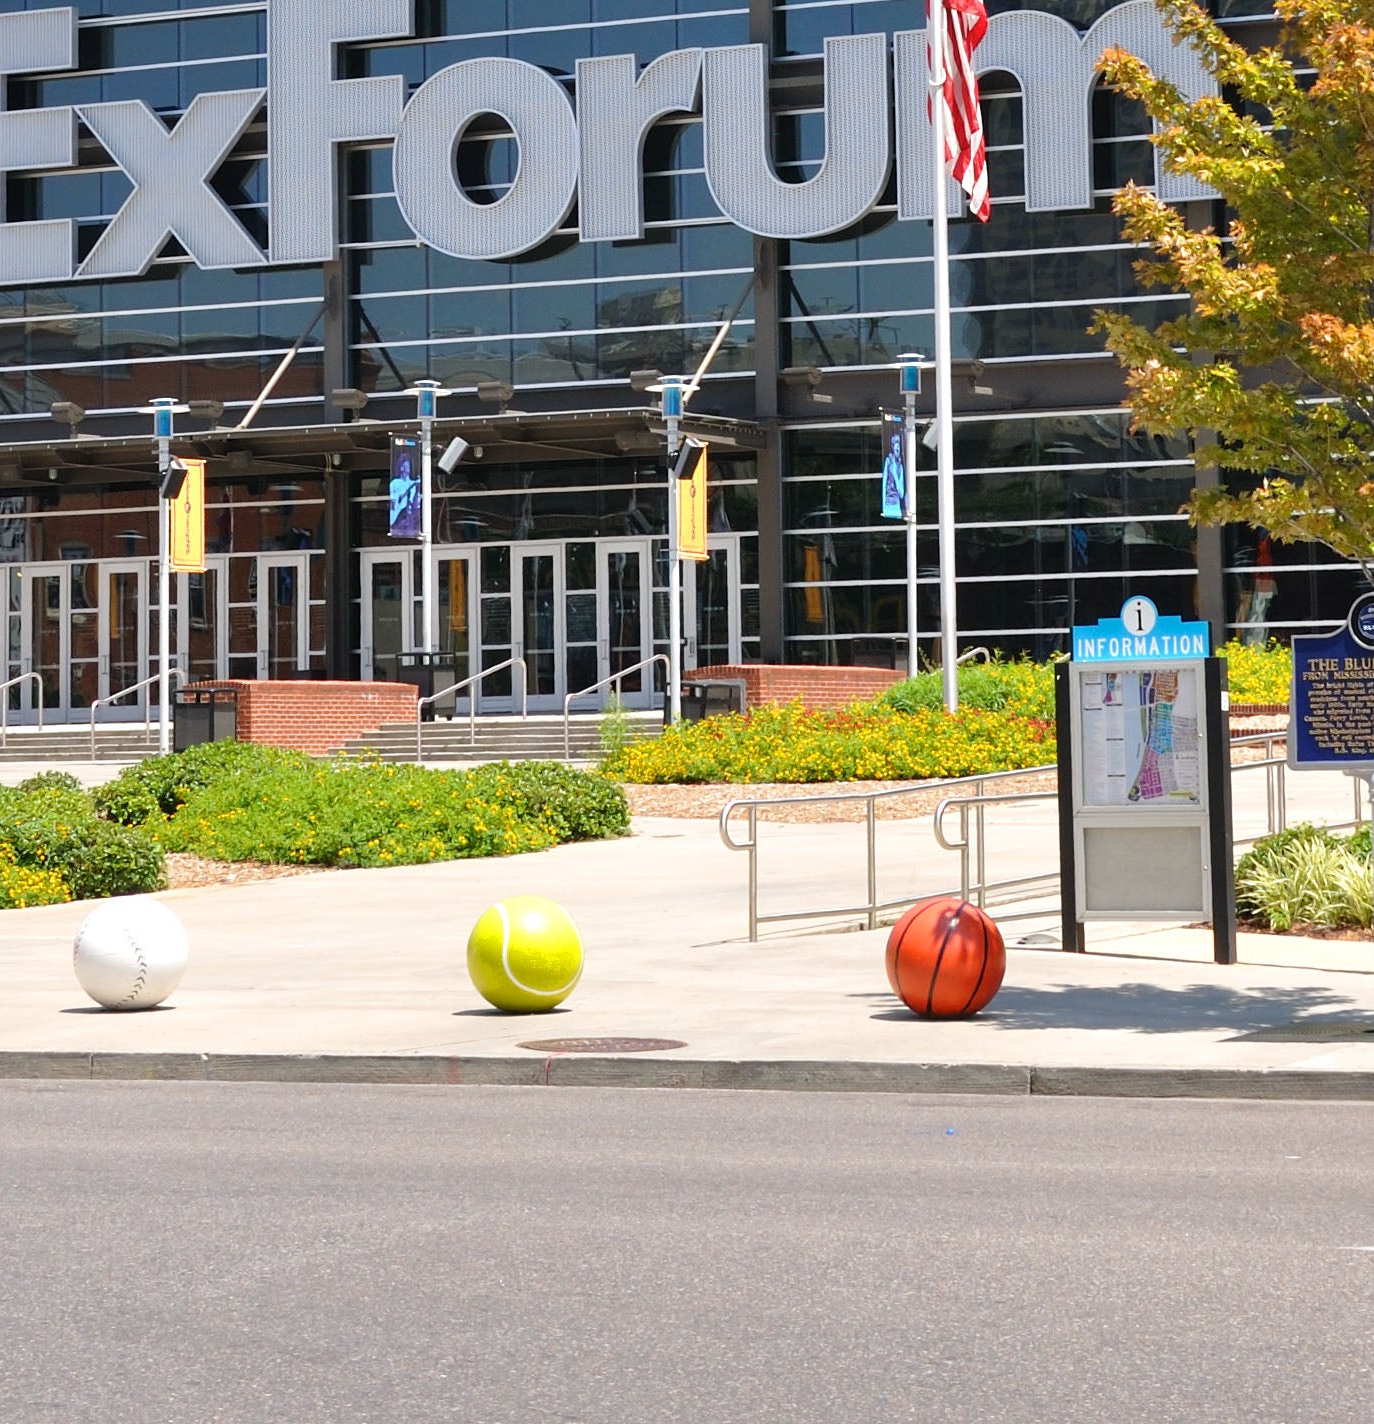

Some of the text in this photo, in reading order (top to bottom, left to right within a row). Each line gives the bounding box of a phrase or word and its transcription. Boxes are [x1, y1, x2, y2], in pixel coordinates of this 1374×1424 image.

[1077, 634, 1205, 658] INFORMATION
[1308, 659, 1339, 671] THE
[1303, 671, 1329, 681] FROM
